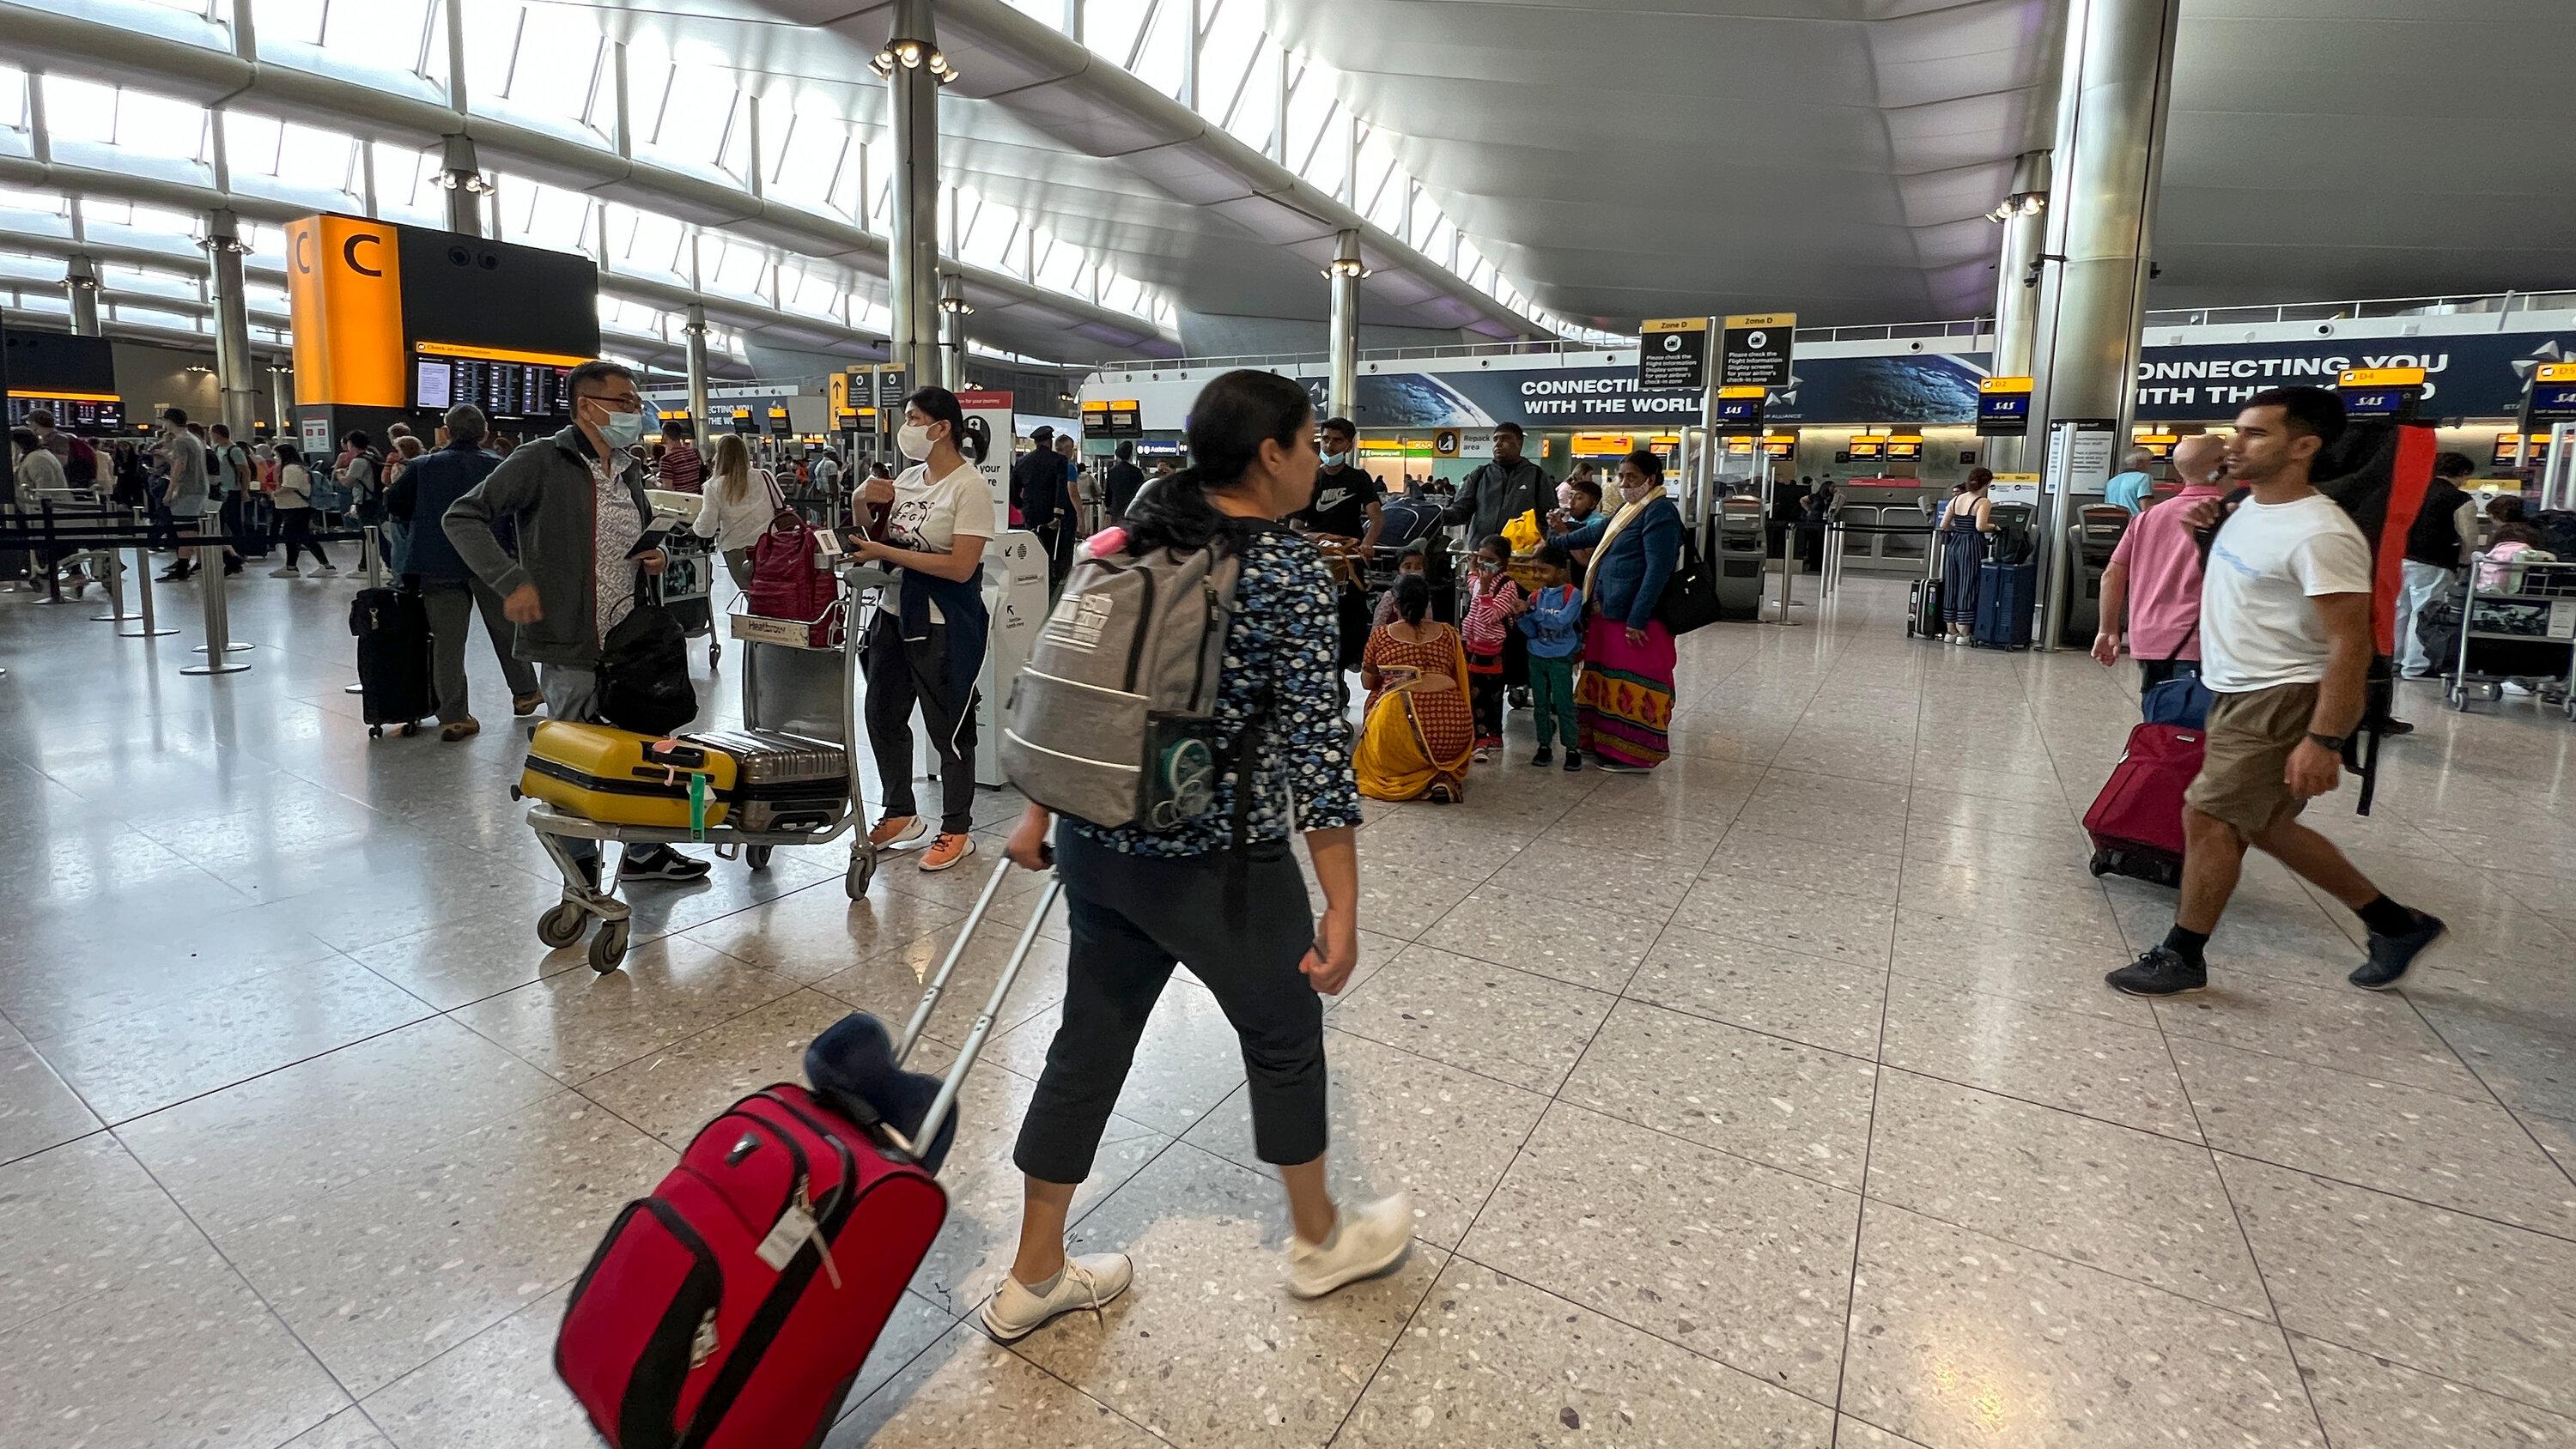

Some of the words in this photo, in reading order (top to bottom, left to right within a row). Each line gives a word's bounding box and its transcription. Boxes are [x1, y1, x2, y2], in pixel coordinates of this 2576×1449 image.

[296, 231, 310, 274] C
[343, 233, 382, 277] C
[2137, 356, 2350, 380] ONNECTING
[1521, 379, 1664, 395] CONNECTI
[2136, 387, 2195, 404] ITH
[2205, 385, 2279, 403] TH
[1524, 400, 1577, 414] WITH
[1582, 398, 1625, 413] THE
[1631, 397, 1704, 412] WORL
[1993, 402, 2015, 410] SAS
[2354, 397, 2385, 406] SAS
[2553, 393, 2576, 403] SA
[980, 465, 1000, 478] your
[1321, 487, 1347, 502] NIKE
